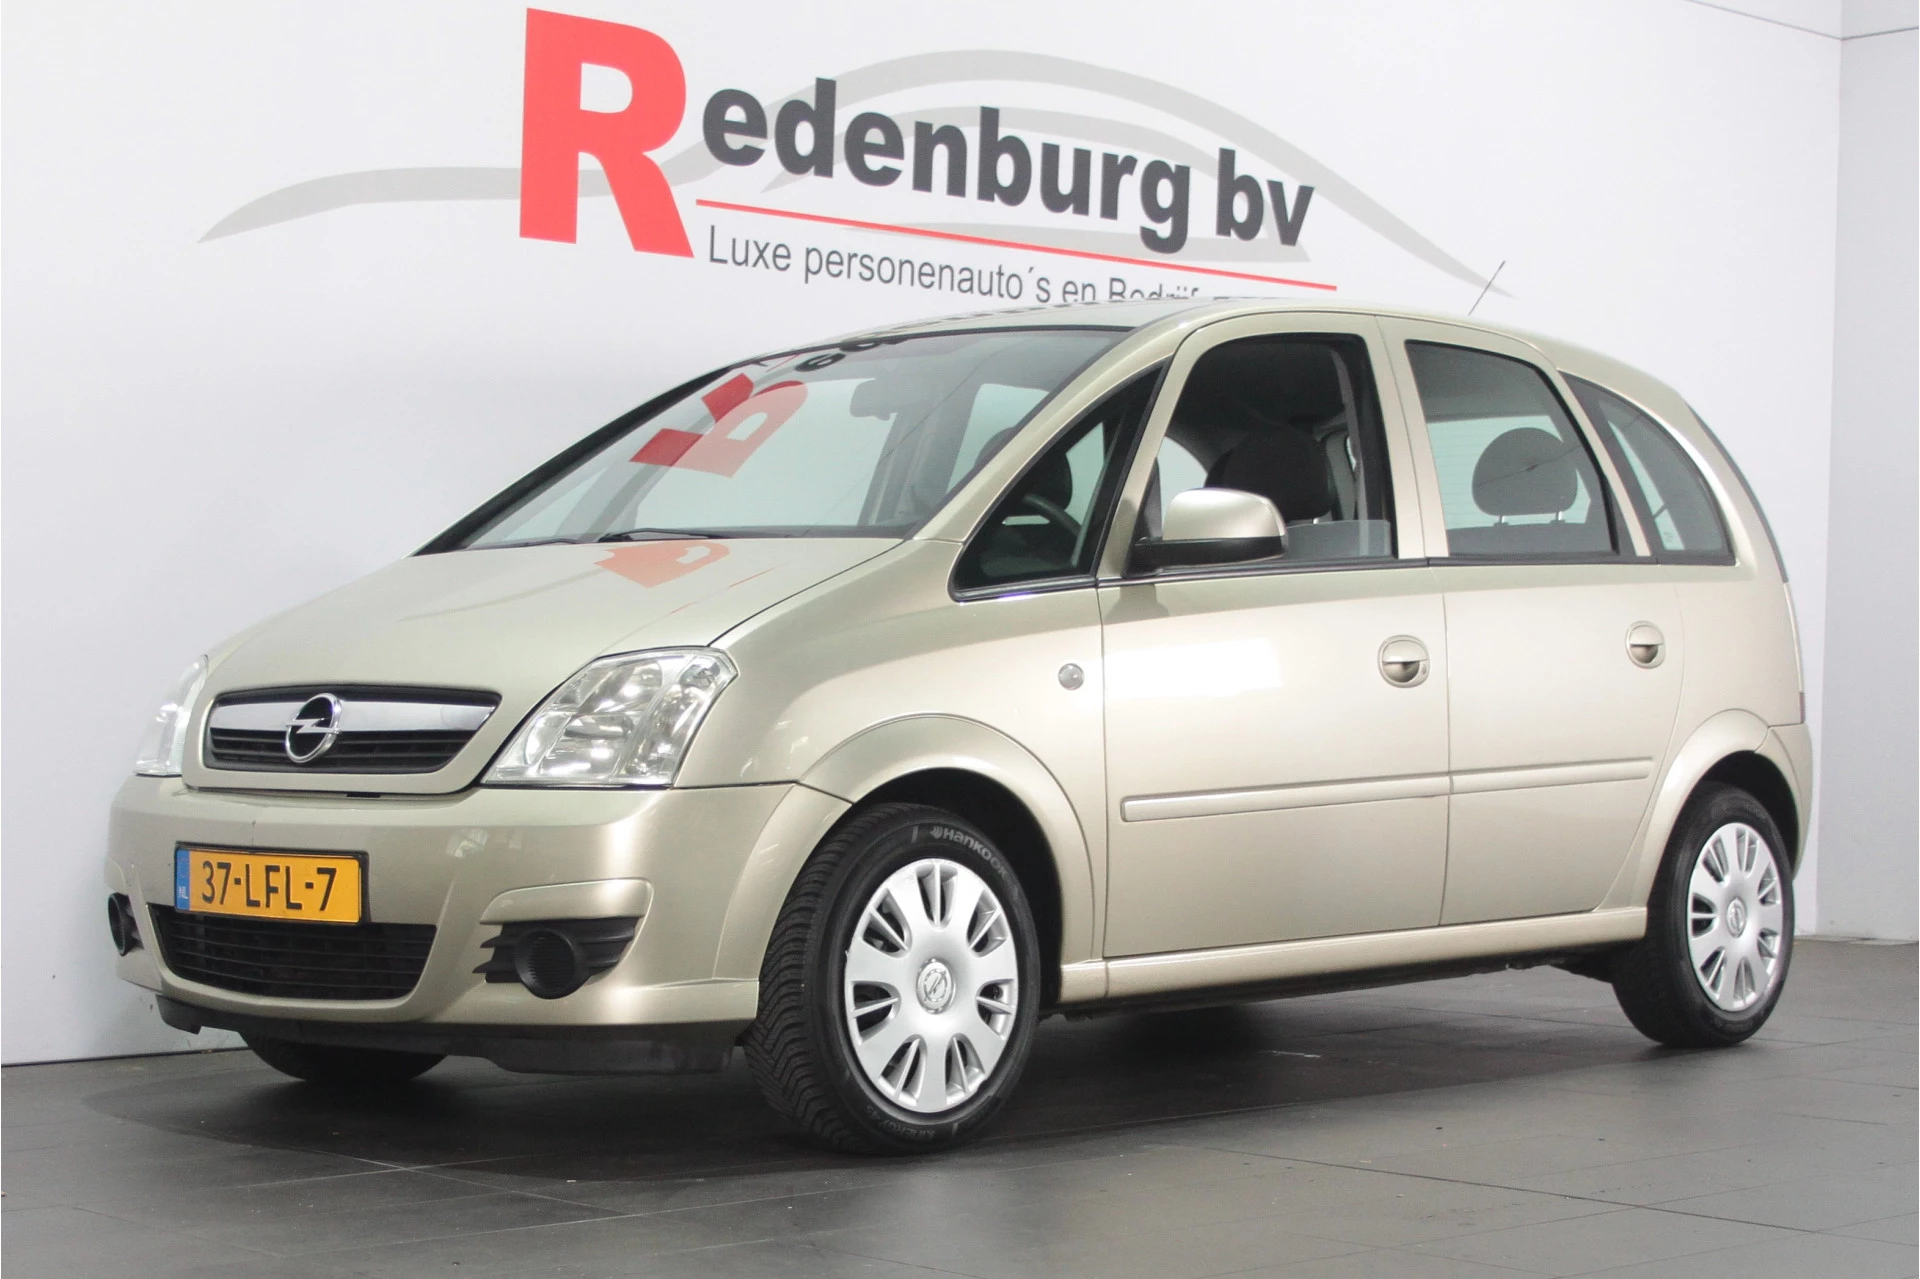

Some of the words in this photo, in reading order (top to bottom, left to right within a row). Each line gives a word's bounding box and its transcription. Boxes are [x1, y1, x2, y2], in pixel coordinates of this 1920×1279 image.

[520, 8, 1190, 257] Redenburg
[1217, 148, 1314, 246] bv
[709, 225, 791, 272] Luxe
[1061, 279, 1097, 302] en
[202, 860, 337, 912] 37-LFL-7
